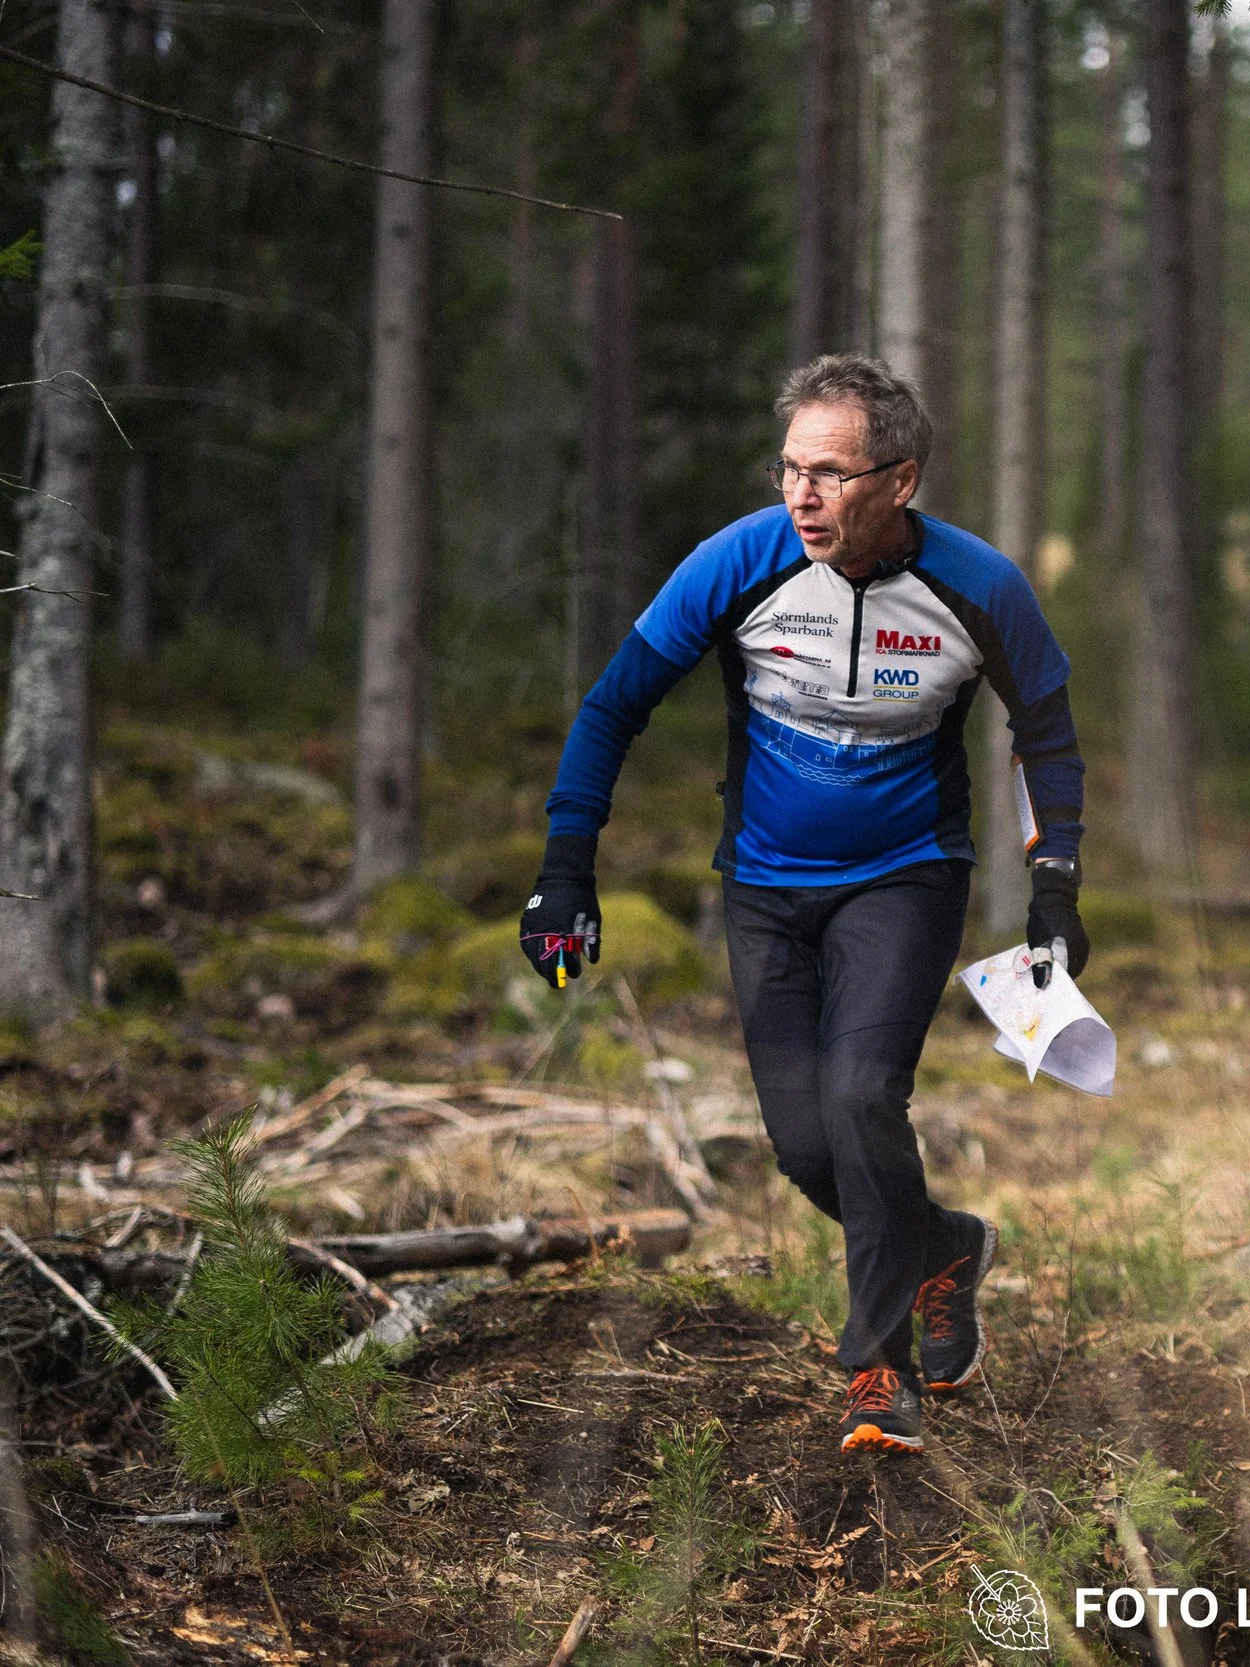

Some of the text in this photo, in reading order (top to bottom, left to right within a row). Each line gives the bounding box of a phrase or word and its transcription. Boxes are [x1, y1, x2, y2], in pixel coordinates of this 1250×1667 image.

[772, 611, 839, 625] Sörmlands
[774, 622, 834, 638] Sparbank
[876, 629, 942, 651] MAXI
[888, 649, 941, 657] STORMARKNAD
[873, 668, 920, 686] KWD
[873, 689, 919, 699] GROUP
